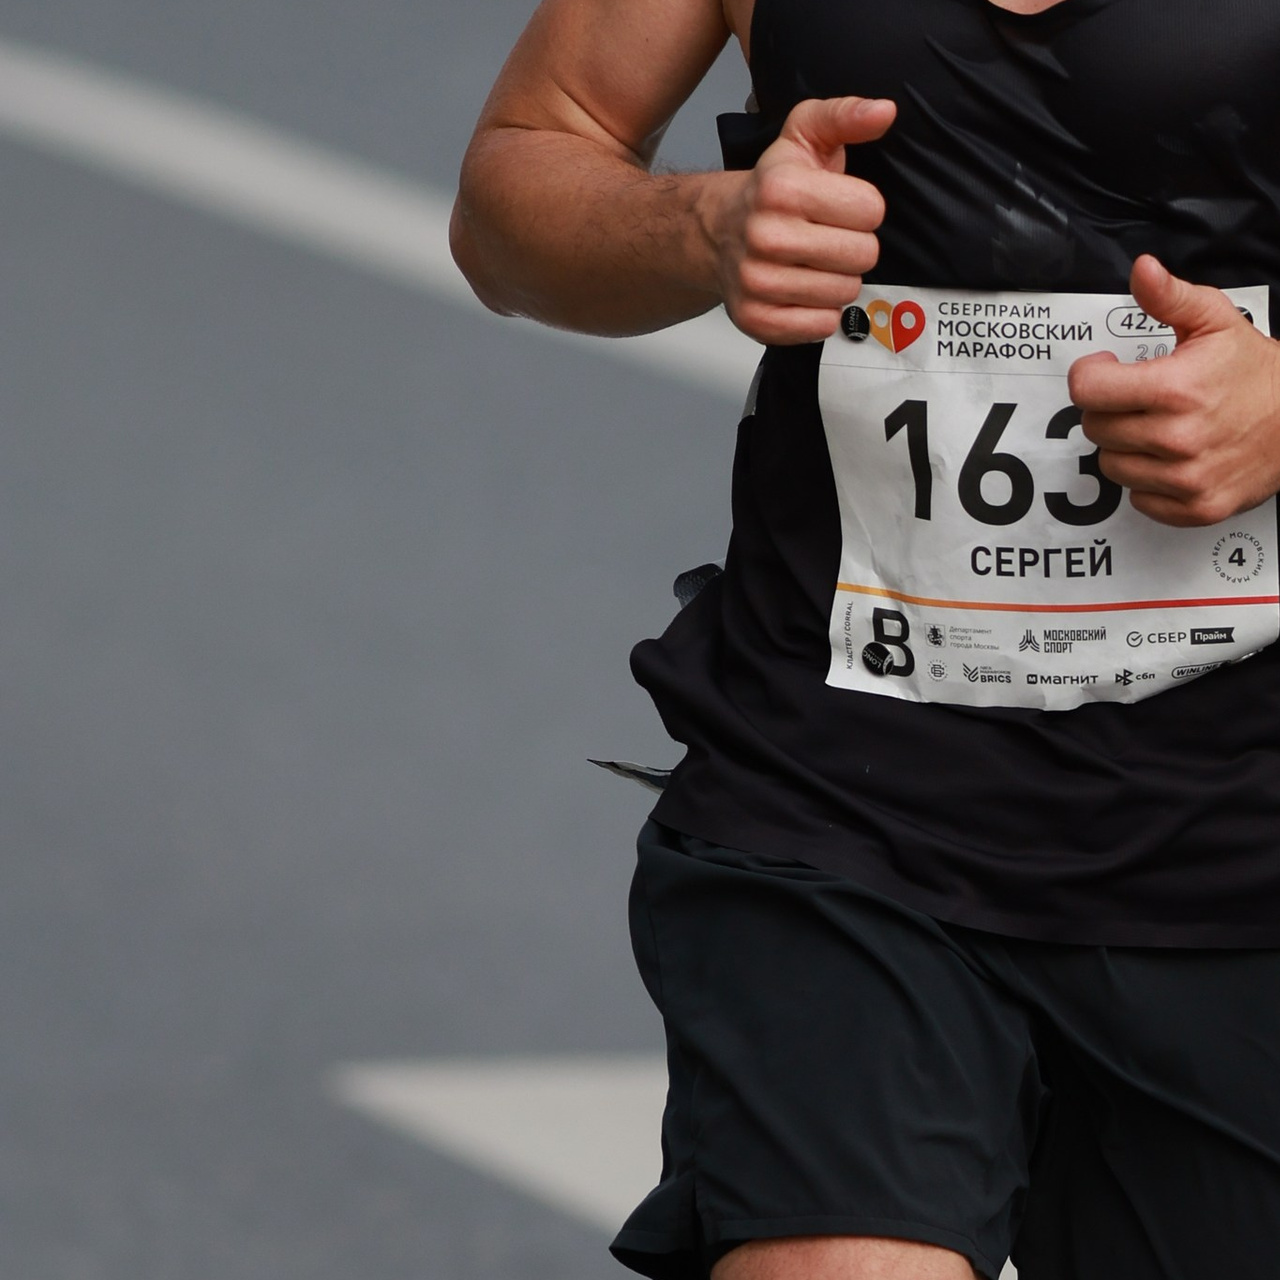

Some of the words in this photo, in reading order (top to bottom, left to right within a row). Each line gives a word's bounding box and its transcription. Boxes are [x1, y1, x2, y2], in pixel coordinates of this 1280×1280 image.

[937, 301, 1051, 319] СБЕРПРАЙМ
[937, 320, 1093, 342] МОСКОВСКИЙ
[936, 341, 1051, 361] МАРАФОН
[970, 538, 1113, 578] СЕРГЕЙ
[1228, 547, 1246, 567] 4
[1229, 531, 1265, 576] МОСКОВСКИЙ
[1212, 559, 1251, 584] МАРАФОН
[844, 601, 854, 631] CORRAL
[1043, 626, 1107, 642] МОСКОВСКИЙ
[1147, 632, 1187, 644] СБЕР
[1194, 631, 1227, 642] Прайм
[844, 637, 854, 670] КЛАСТЕР
[1043, 641, 1074, 654] СПОРТ
[980, 674, 1012, 684] BRICS
[1040, 675, 1099, 685] магнит
[1135, 673, 1156, 681] сбп
